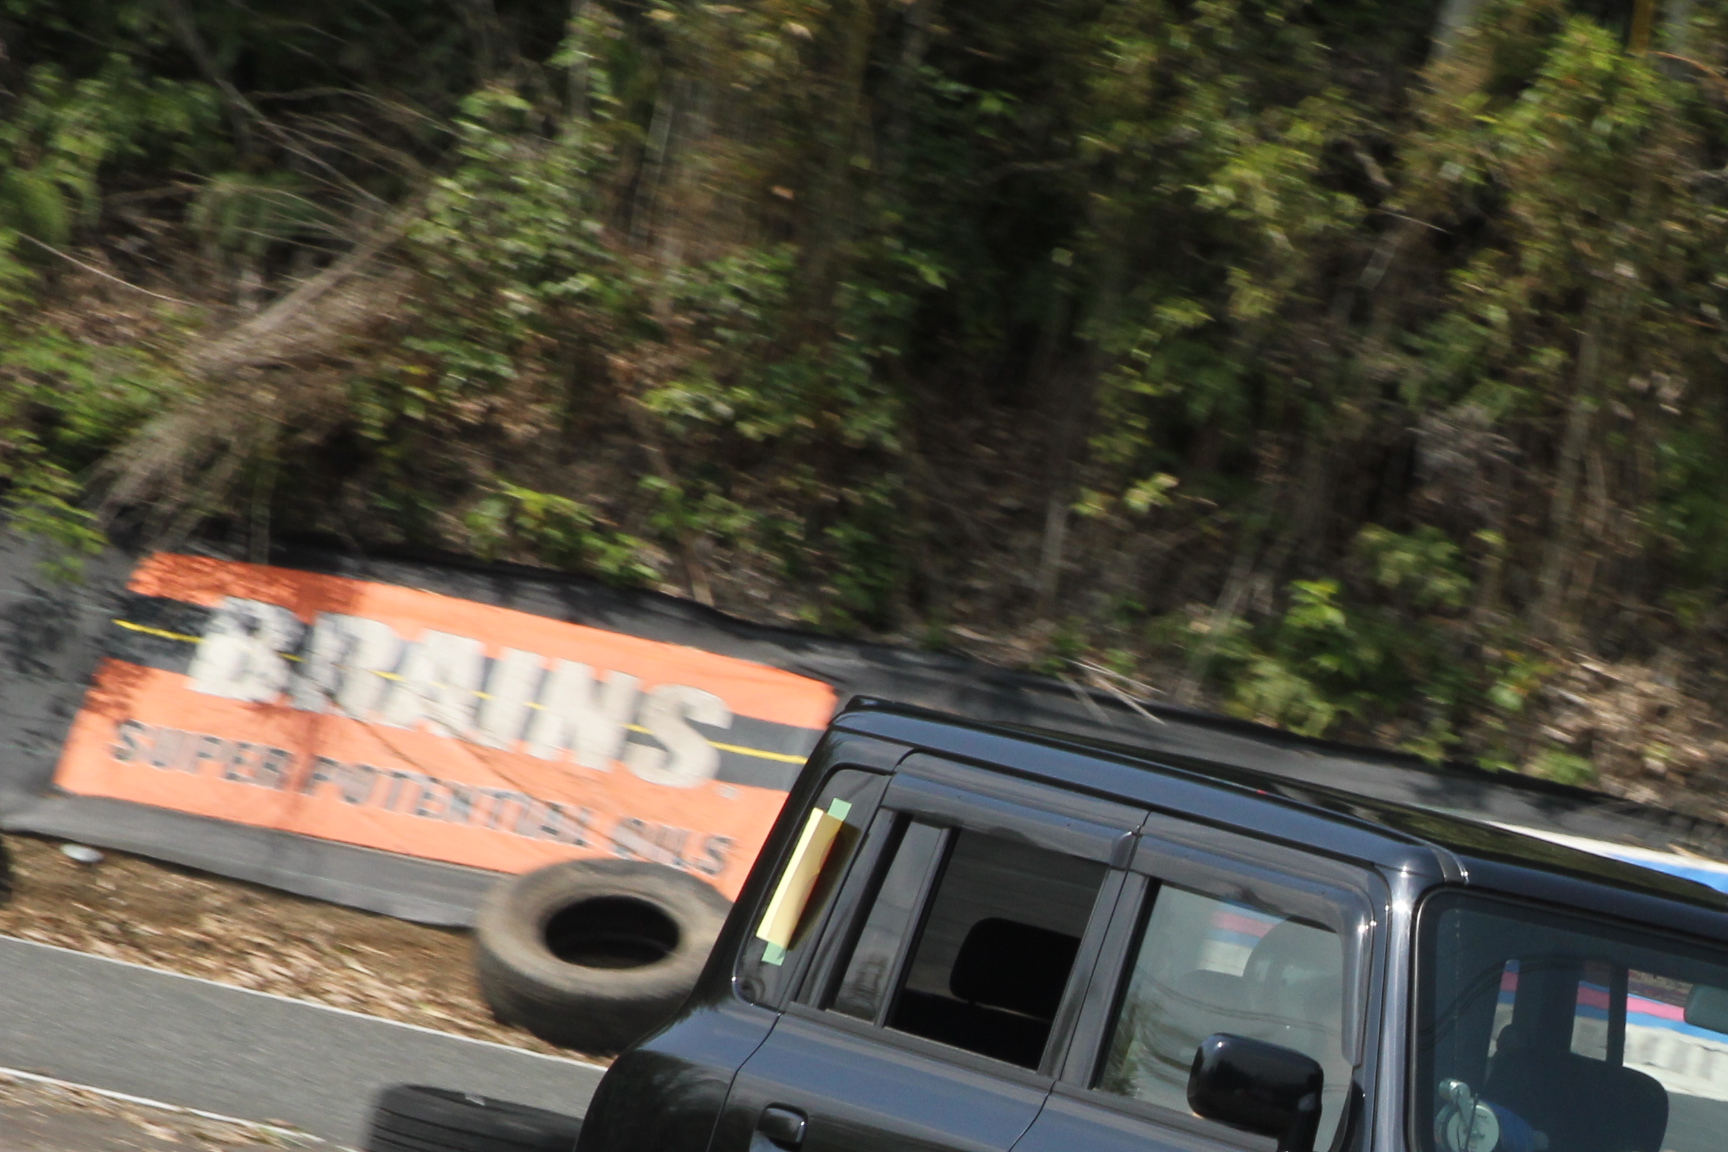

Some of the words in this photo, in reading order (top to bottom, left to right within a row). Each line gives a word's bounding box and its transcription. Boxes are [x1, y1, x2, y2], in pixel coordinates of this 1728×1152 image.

[185, 596, 733, 788] BRAINS
[109, 719, 293, 791] SUPER
[301, 754, 594, 851] POTENTIAL
